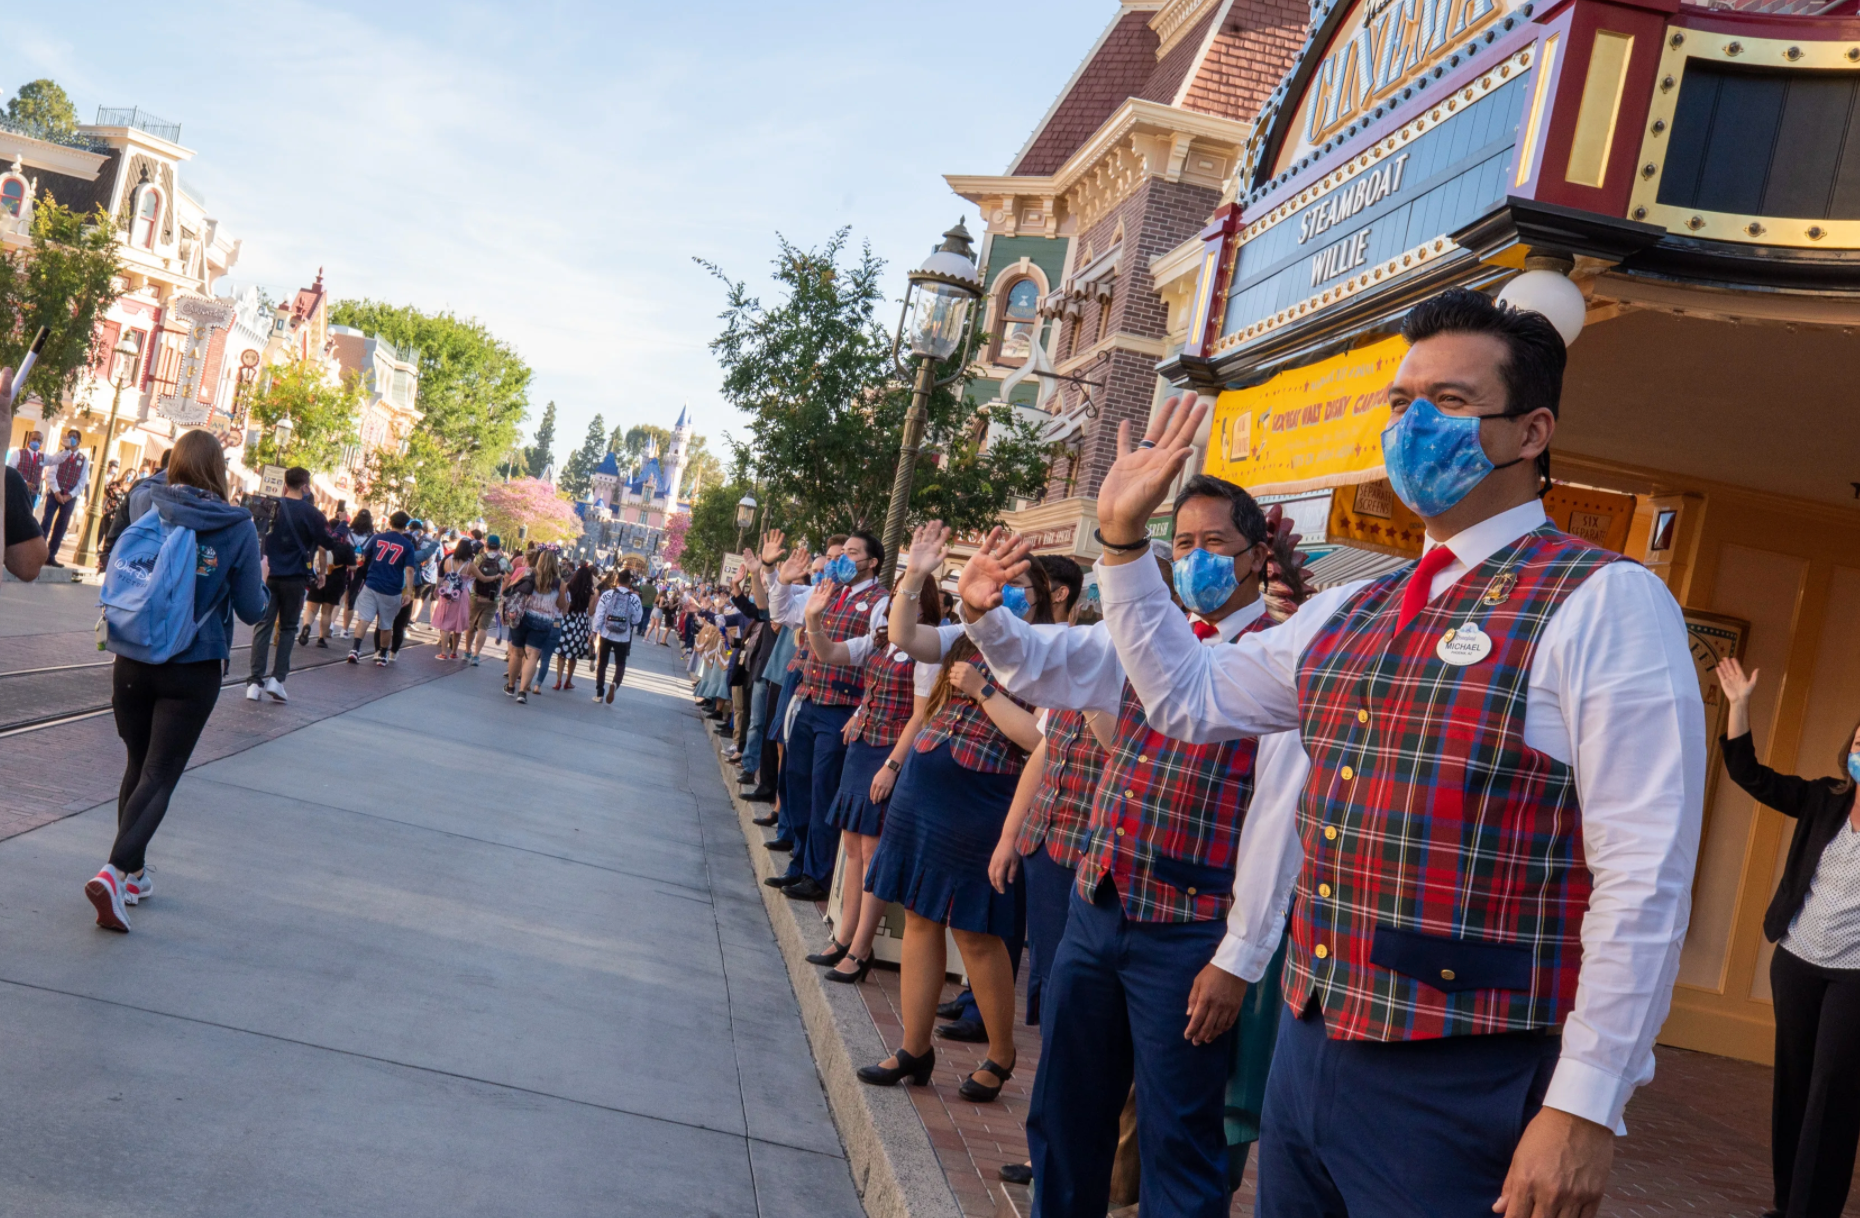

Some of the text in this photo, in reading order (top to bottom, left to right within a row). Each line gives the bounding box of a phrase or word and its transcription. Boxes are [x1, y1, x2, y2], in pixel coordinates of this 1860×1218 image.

[1298, 152, 1410, 245] STEAMBOAT
[1310, 228, 1372, 288] WILLIE
[181, 326, 206, 399] CAFE
[1359, 484, 1392, 503] SEPARATE
[1358, 497, 1389, 514] SCREENS
[1583, 515, 1599, 528] SIX
[376, 540, 404, 565] 77
[1444, 642, 1482, 652] MICHAEL
